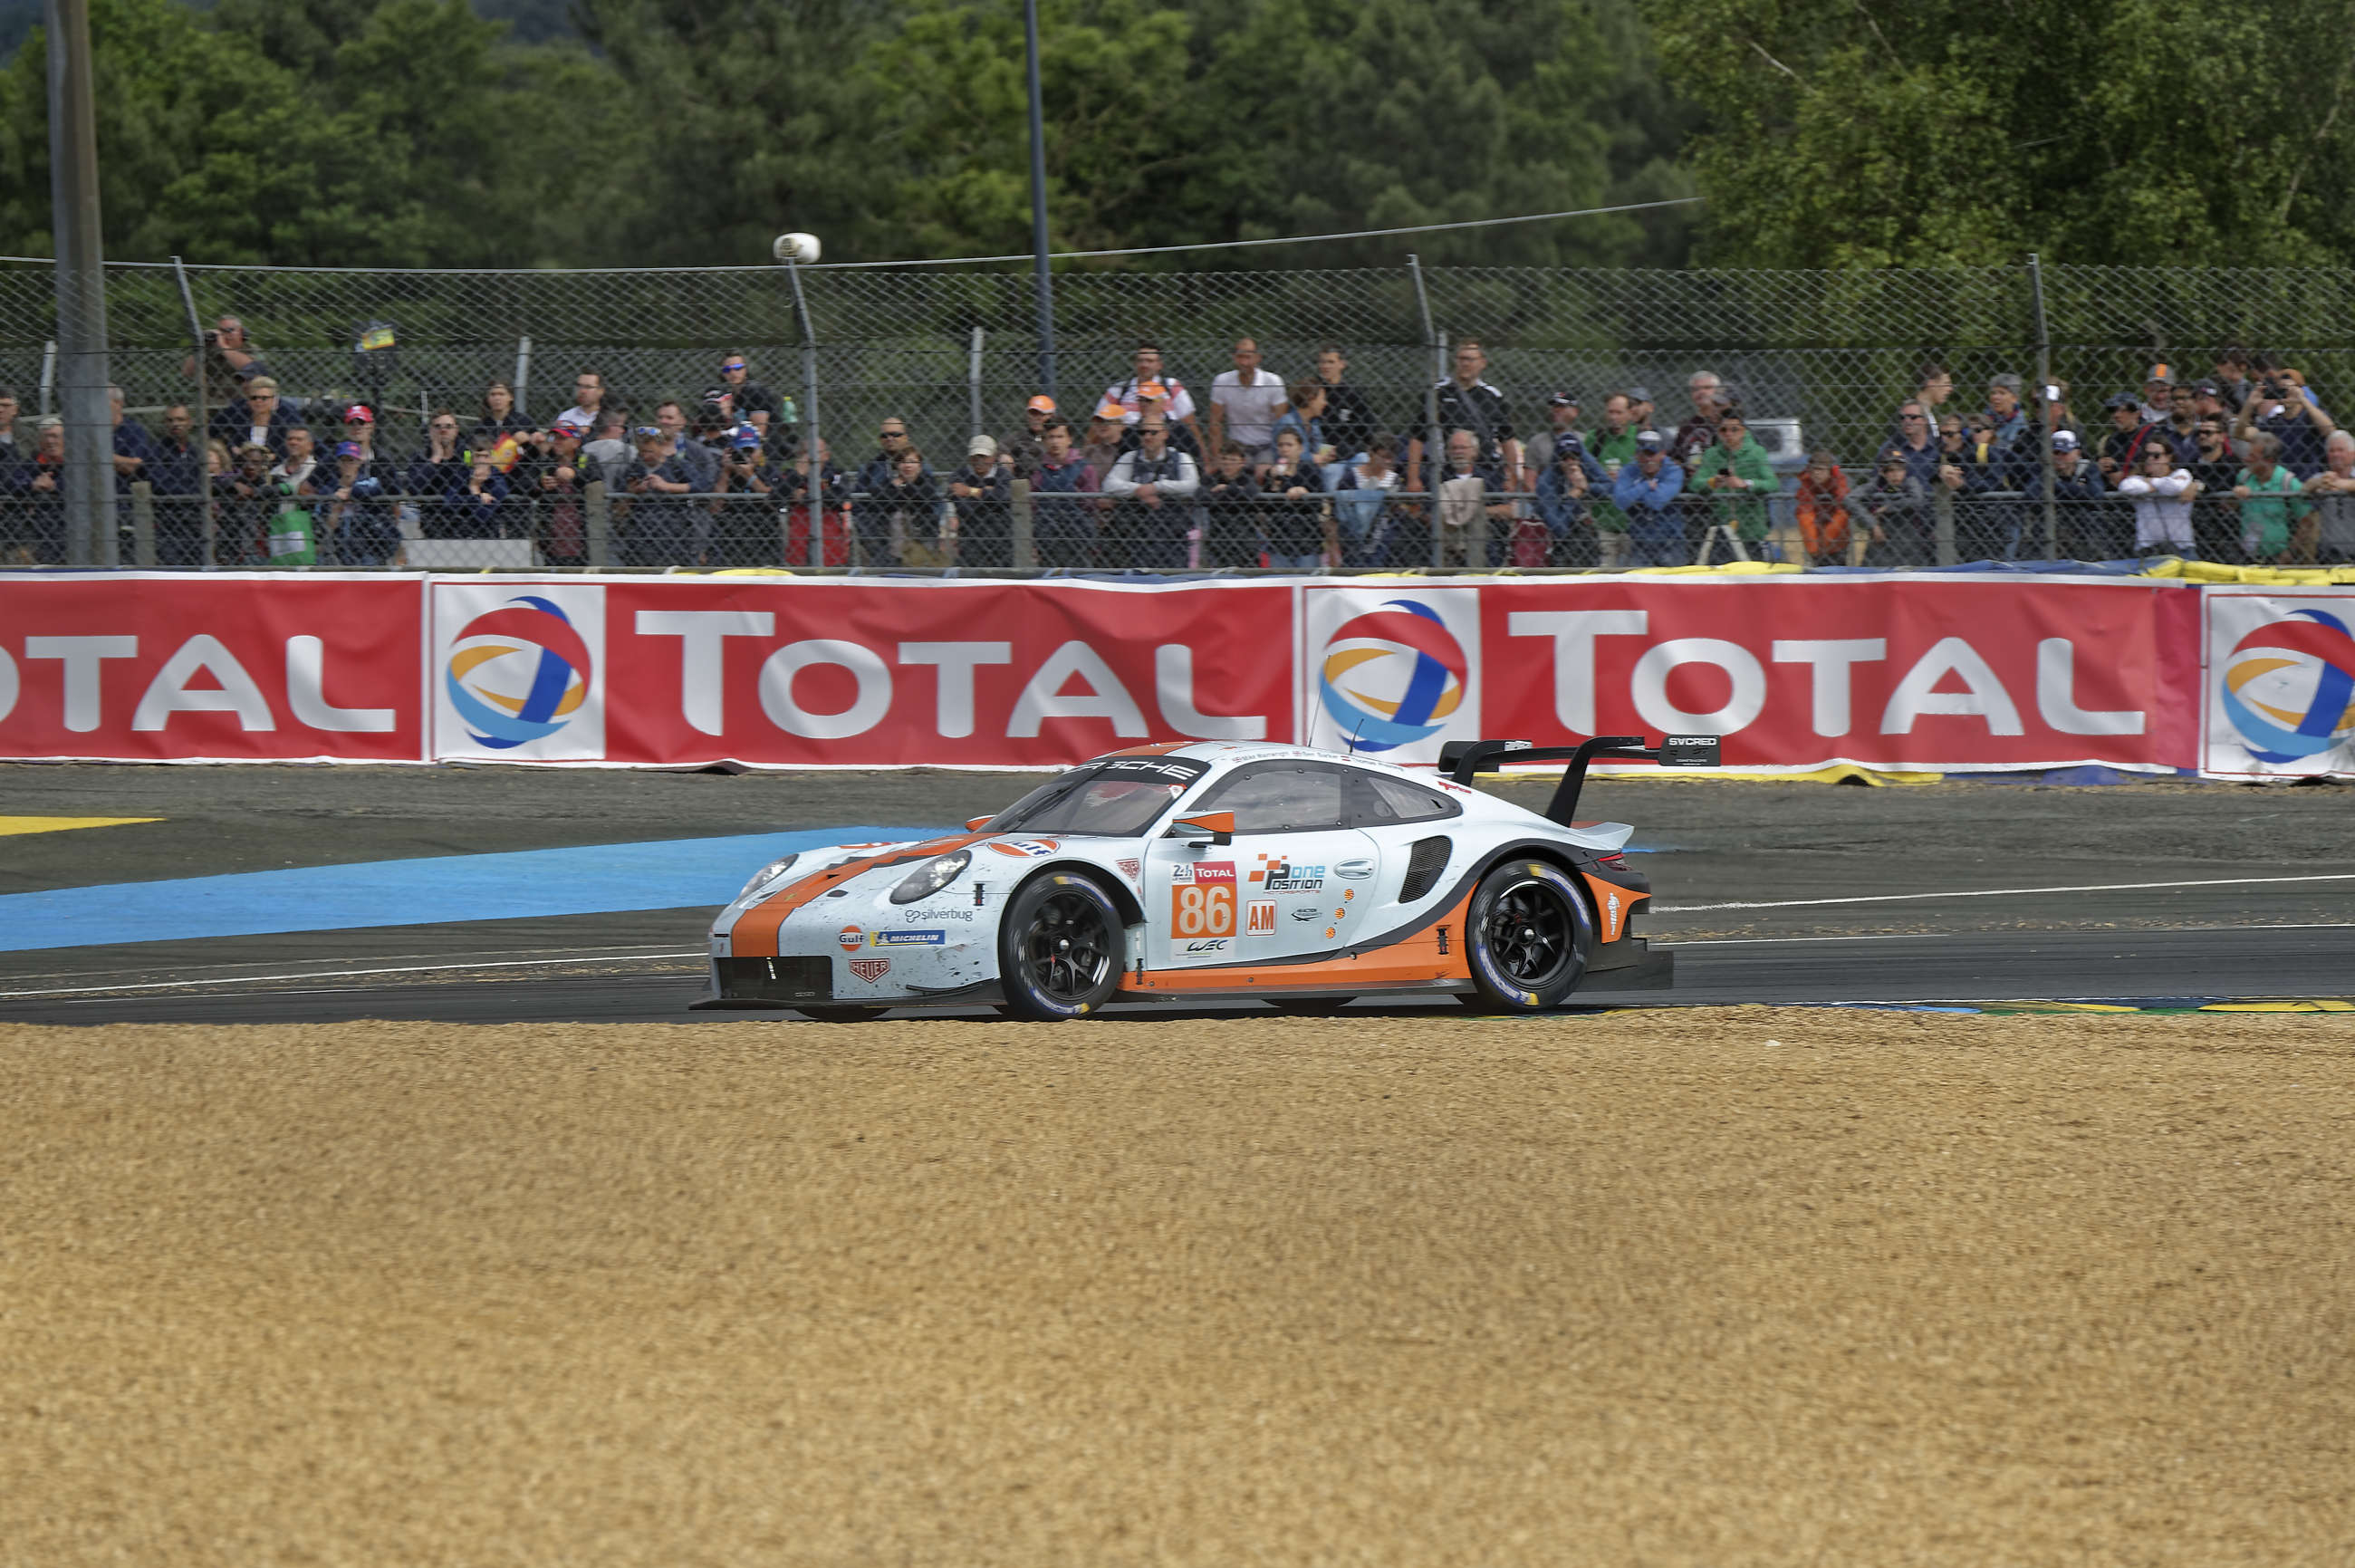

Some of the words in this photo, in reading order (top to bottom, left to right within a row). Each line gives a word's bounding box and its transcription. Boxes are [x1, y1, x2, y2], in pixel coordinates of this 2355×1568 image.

[635, 610, 1266, 740] TOTAL
[1508, 610, 2145, 736] TOTAL
[0, 633, 396, 733] TAL
[1196, 868, 1235, 878] TOTAL
[921, 909, 974, 922] silverbug
[1178, 886, 1232, 935] 86
[1248, 905, 1274, 930] AM
[839, 934, 865, 944] Gulf
[889, 934, 939, 942] MICHELIN
[1187, 939, 1228, 952] WEC
[851, 962, 888, 979] HEUER
